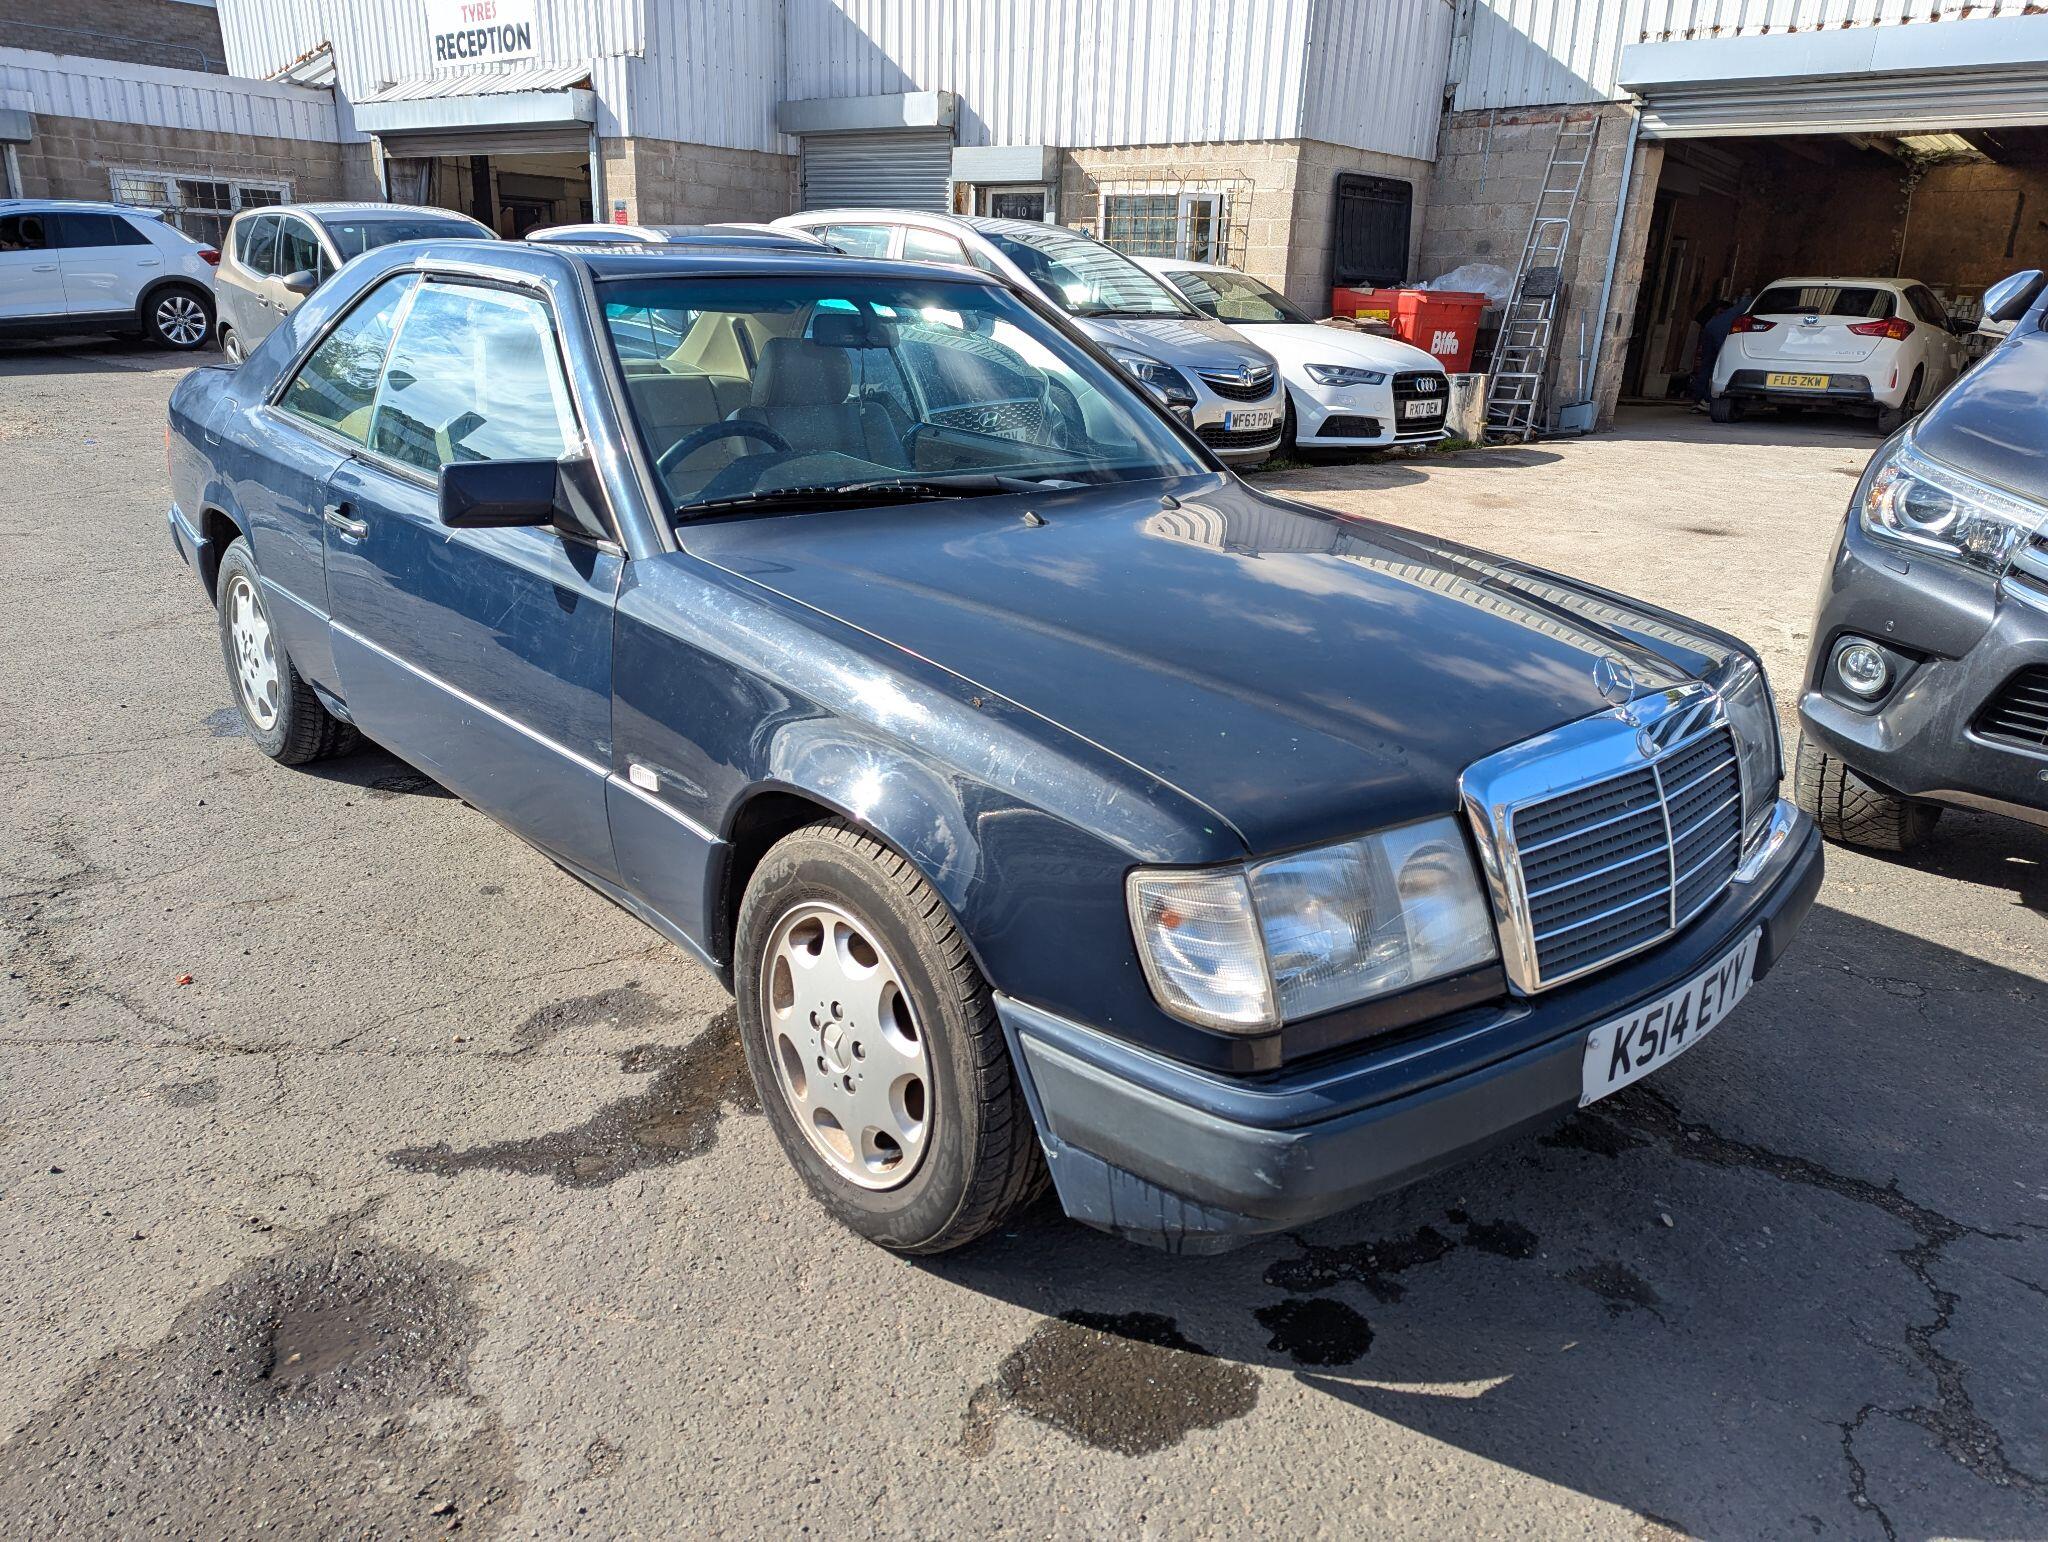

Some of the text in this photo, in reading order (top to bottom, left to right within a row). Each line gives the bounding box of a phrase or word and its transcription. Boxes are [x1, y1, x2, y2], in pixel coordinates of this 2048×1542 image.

[461, 1, 496, 23] TYRES
[435, 21, 531, 61] RECEPTION
[1017, 206, 1027, 217] 10
[1430, 331, 1458, 354] Biffa
[1773, 375, 1822, 387] FL15 ZKW
[1410, 401, 1439, 416] RX17 OEW
[1232, 411, 1273, 428] WF63 PBX
[1608, 946, 1747, 1082] K514 EYY
